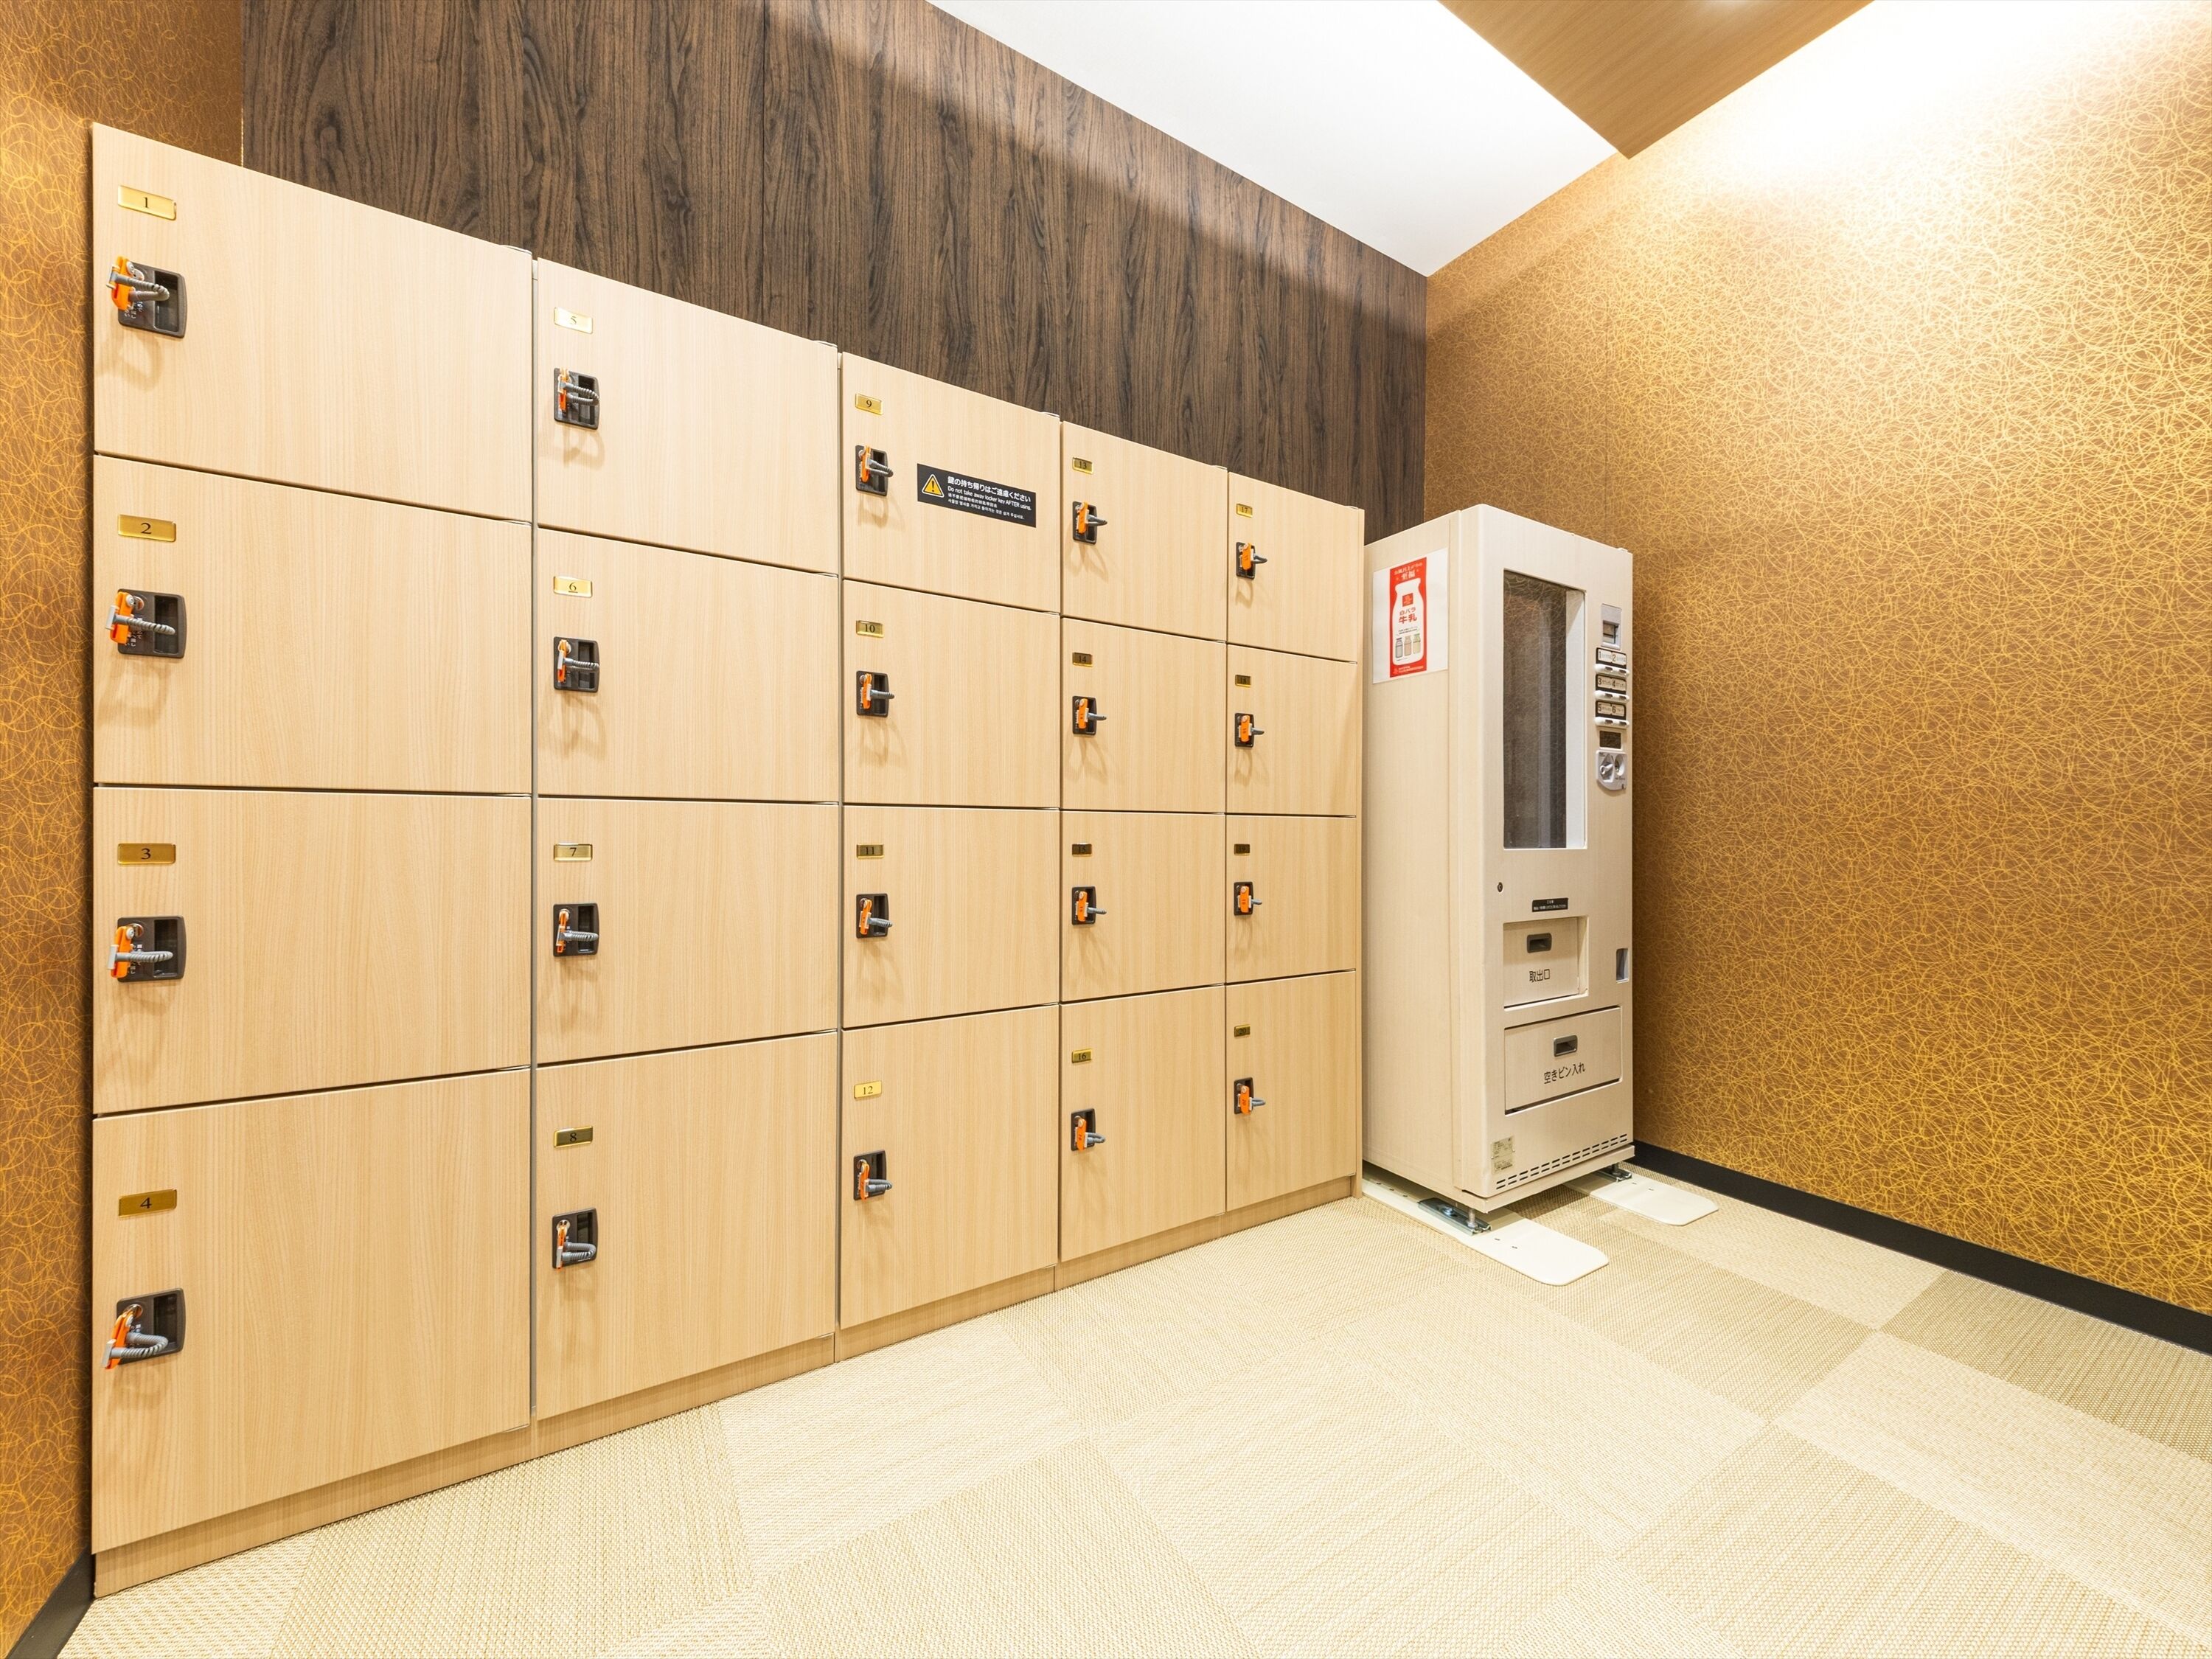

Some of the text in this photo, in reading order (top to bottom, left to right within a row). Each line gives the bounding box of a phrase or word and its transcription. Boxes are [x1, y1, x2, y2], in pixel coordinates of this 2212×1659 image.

[570, 316, 577, 325] 5
[866, 400, 872, 408] 9
[1079, 461, 1087, 469] 13
[947, 476, 1031, 502] 鍵の持ち帰りはご遠慮ください
[141, 523, 151, 535] 2
[569, 583, 577, 591] 6
[1399, 606, 1416, 615] 白バラ
[1399, 613, 1417, 625] 牛乳
[865, 624, 875, 633] 10
[141, 848, 151, 860] 3
[569, 847, 577, 856] 7
[865, 846, 875, 856] 11
[1529, 969, 1551, 983] 取出口
[1078, 1052, 1087, 1060] 16
[1544, 1062, 1586, 1085] 空きビン入れ
[863, 1085, 874, 1094] 12
[569, 1133, 577, 1142] 8
[140, 1197, 152, 1209] 4
